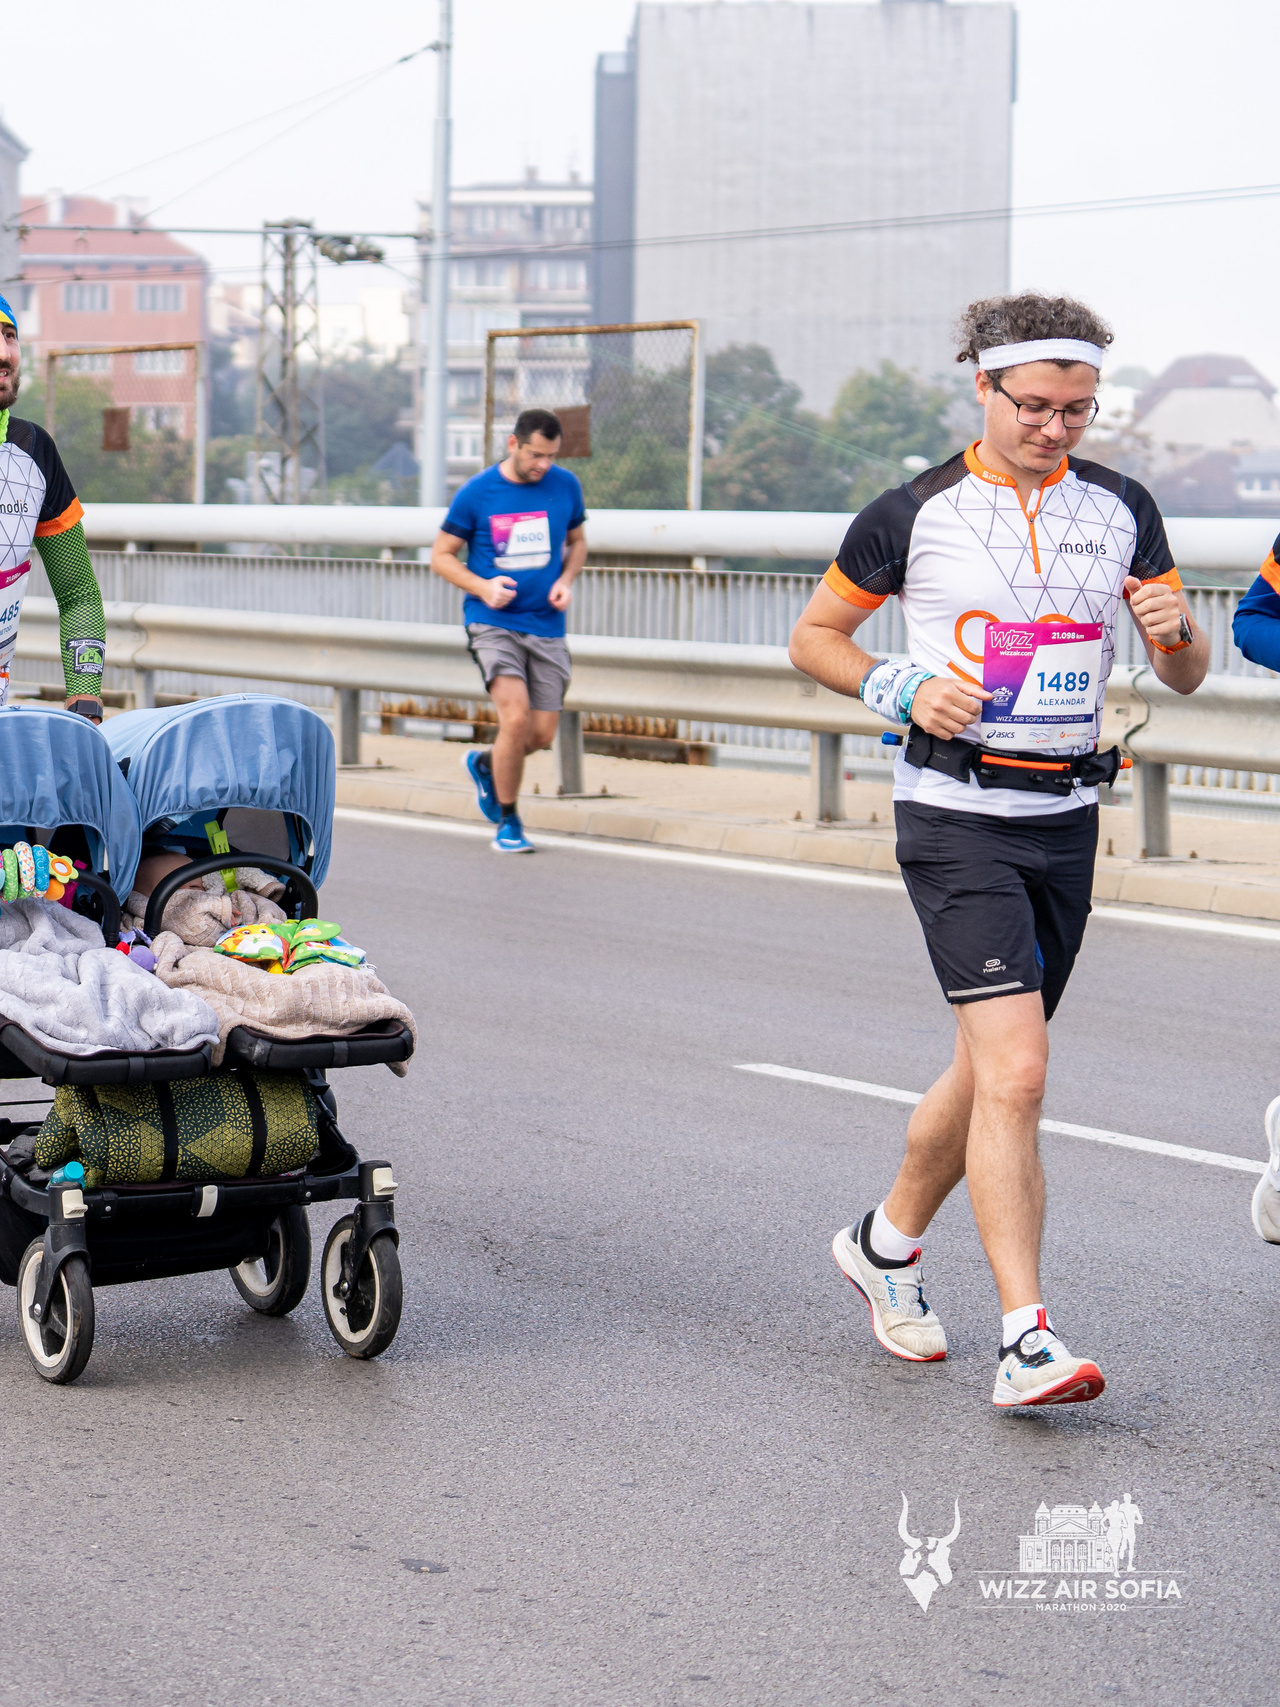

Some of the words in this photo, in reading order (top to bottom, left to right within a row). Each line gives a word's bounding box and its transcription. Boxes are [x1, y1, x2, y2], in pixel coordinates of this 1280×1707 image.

[515, 531, 544, 543] 1600
[1059, 539, 1107, 555] modis
[1037, 671, 1090, 692] 1489
[1037, 698, 1086, 706] ALEXANDAR
[888, 1286, 898, 1308] asics
